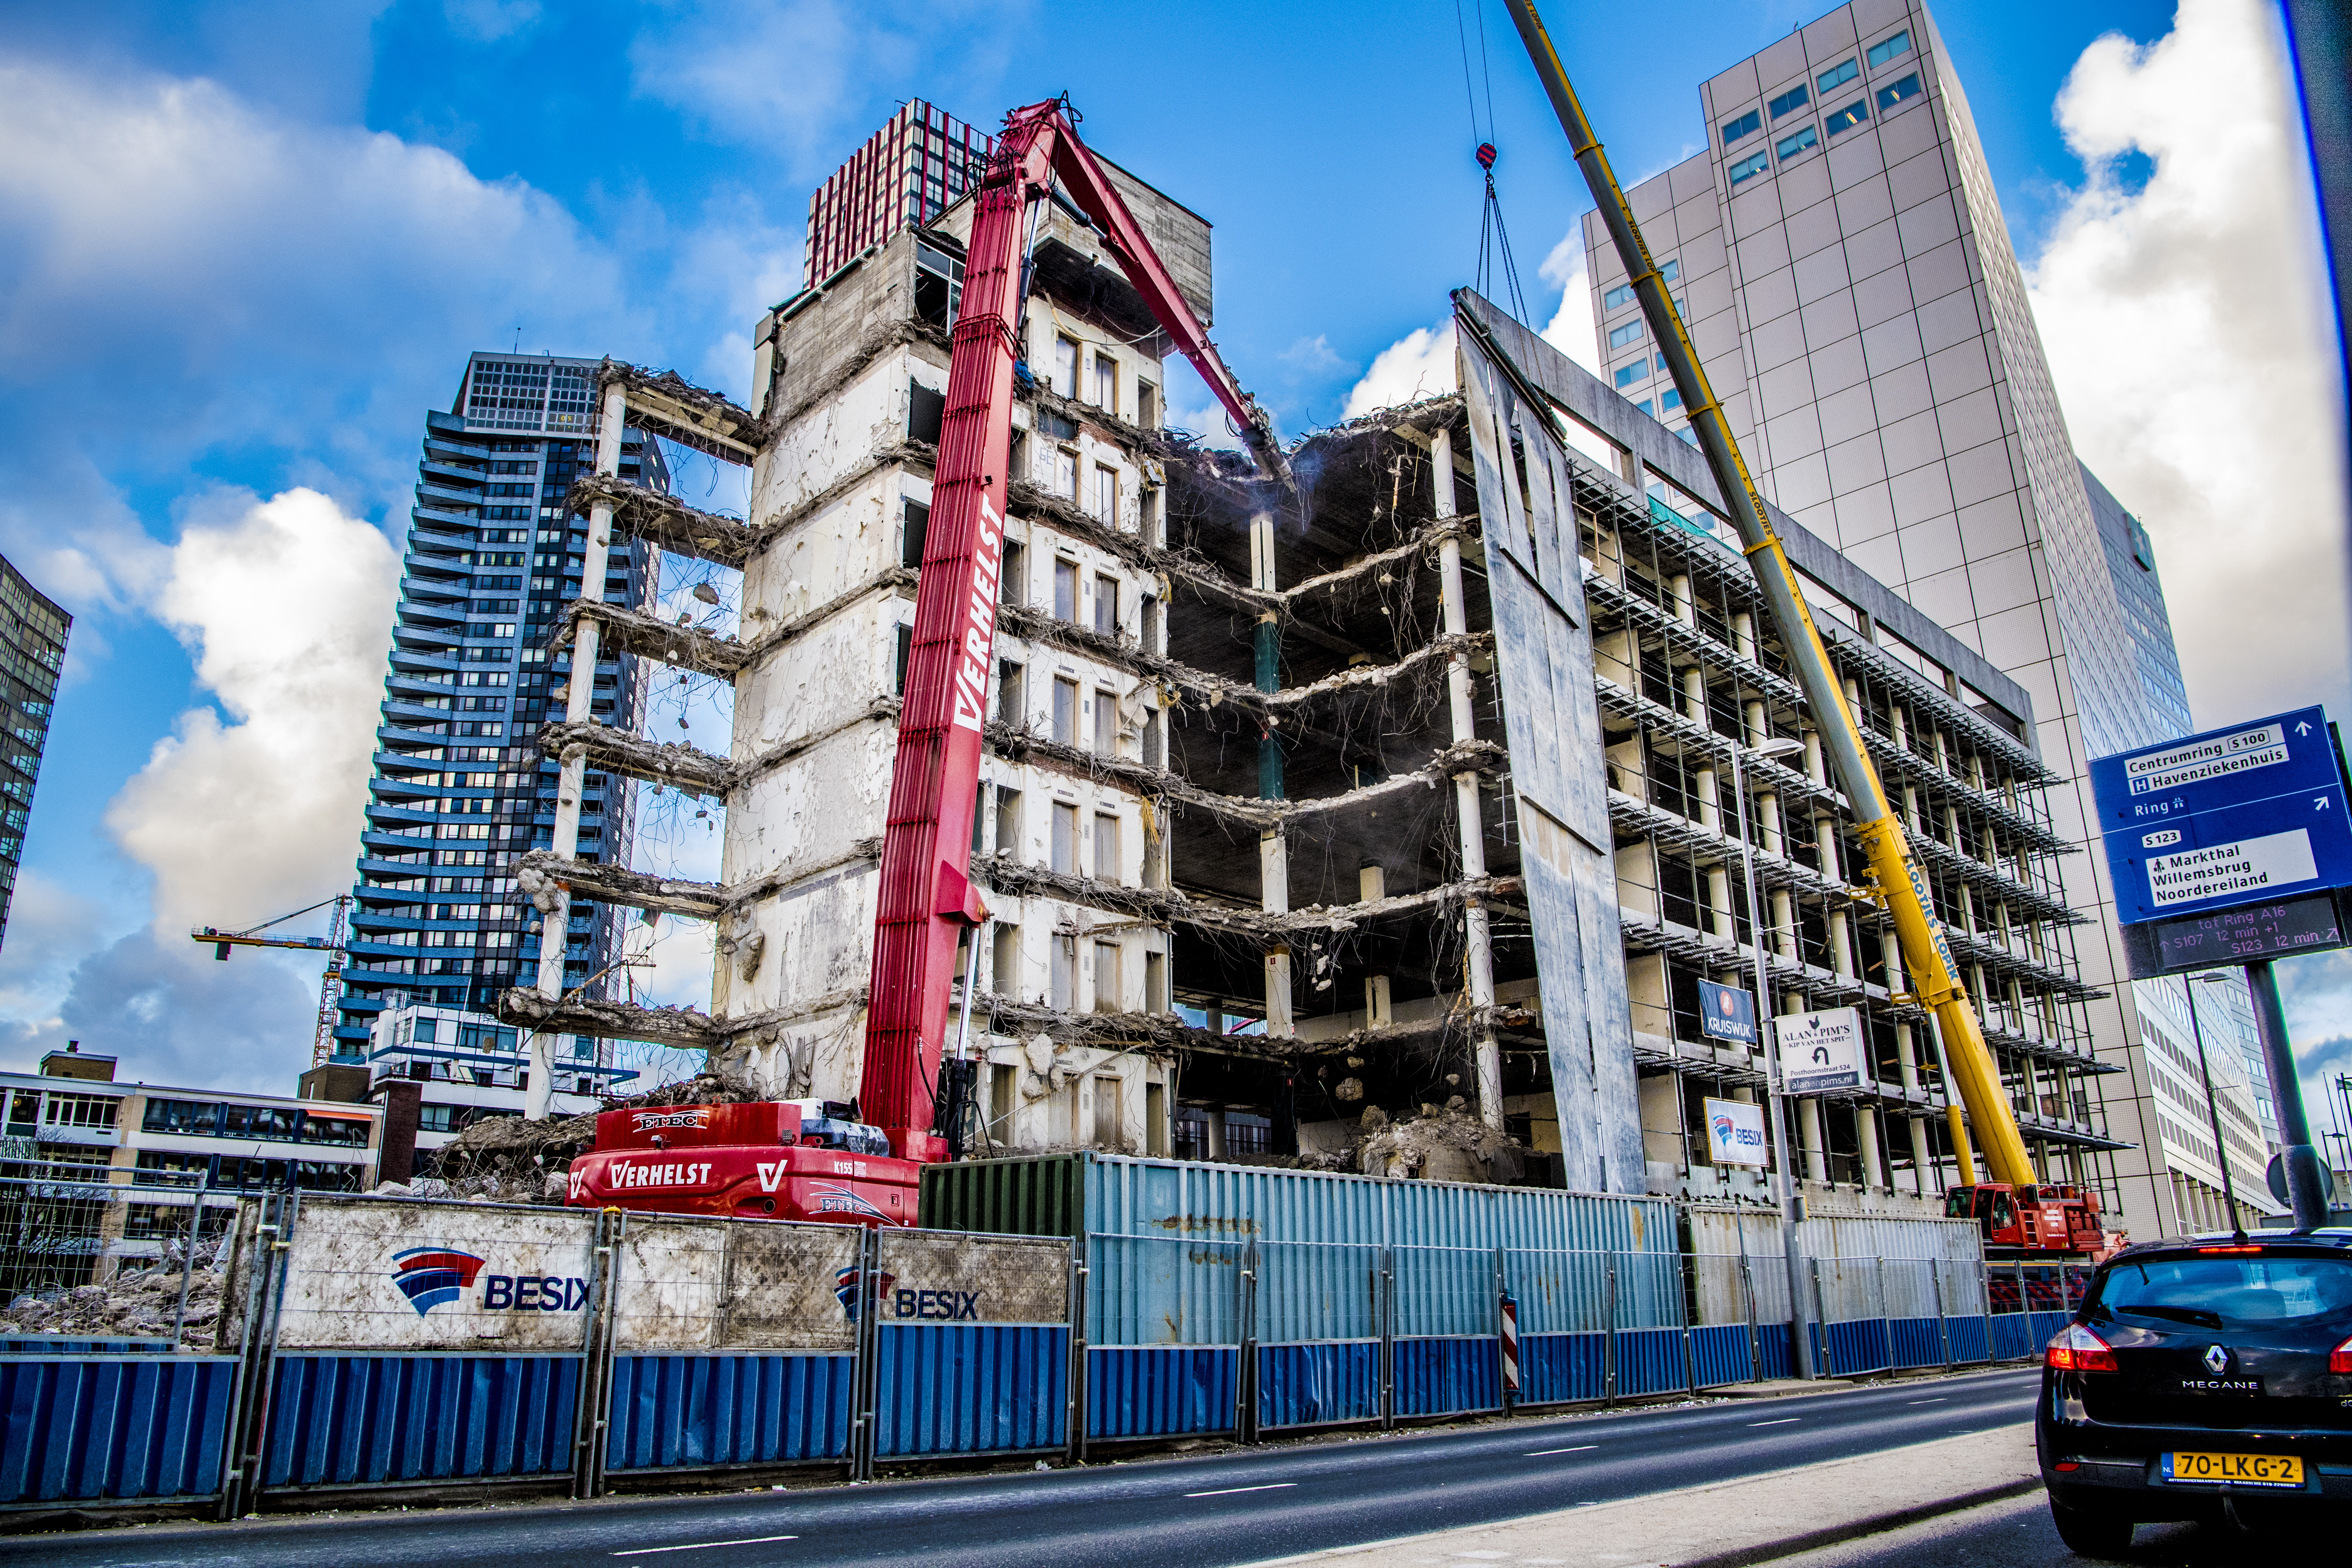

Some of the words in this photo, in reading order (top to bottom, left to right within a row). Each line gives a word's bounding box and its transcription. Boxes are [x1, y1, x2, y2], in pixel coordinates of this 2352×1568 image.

[1530, 10, 1544, 30] LOPIK
[1628, 220, 1647, 256] SLOOTJES
[1749, 491, 1772, 536] SLOOTJES
[953, 492, 1002, 733] VERHELST
[2129, 745, 2222, 773] Centrumring
[2153, 750, 2283, 787] Havenziekenhuis
[2135, 802, 2169, 816] Ring
[2170, 845, 2240, 868] Markthal
[2153, 861, 2251, 886] Willemsbrug
[2156, 872, 2268, 901] Noordereiland
[2199, 918, 2219, 930] tot
[2224, 913, 2254, 925] Ring
[2261, 906, 2286, 920] A16
[2174, 934, 2203, 948] S107
[2216, 931, 2229, 941] 12
[2235, 926, 2259, 938] min
[2265, 922, 2278, 933] +1
[2232, 939, 2262, 953] S123
[2275, 935, 2288, 947] 12
[2295, 931, 2319, 944] min
[1935, 934, 1959, 981] LOPIK
[1708, 1017, 1751, 1038] KRUISWIJK
[1783, 1030, 1811, 1042] ALAN
[1820, 1025, 1850, 1037] PIM'S
[1791, 1066, 1838, 1076] Posthoornstraat
[641, 1114, 698, 1129] ETEC
[1736, 1128, 1763, 1146] BESIX
[611, 1160, 712, 1189] VERHELST
[834, 1161, 852, 1175] K155
[821, 1198, 862, 1214] ETEC
[484, 1275, 598, 1311] BESIX
[896, 1288, 979, 1320] BESIX
[2183, 1380, 2258, 1390] MEGANE
[2181, 1456, 2293, 1478] 70-LKG-2
